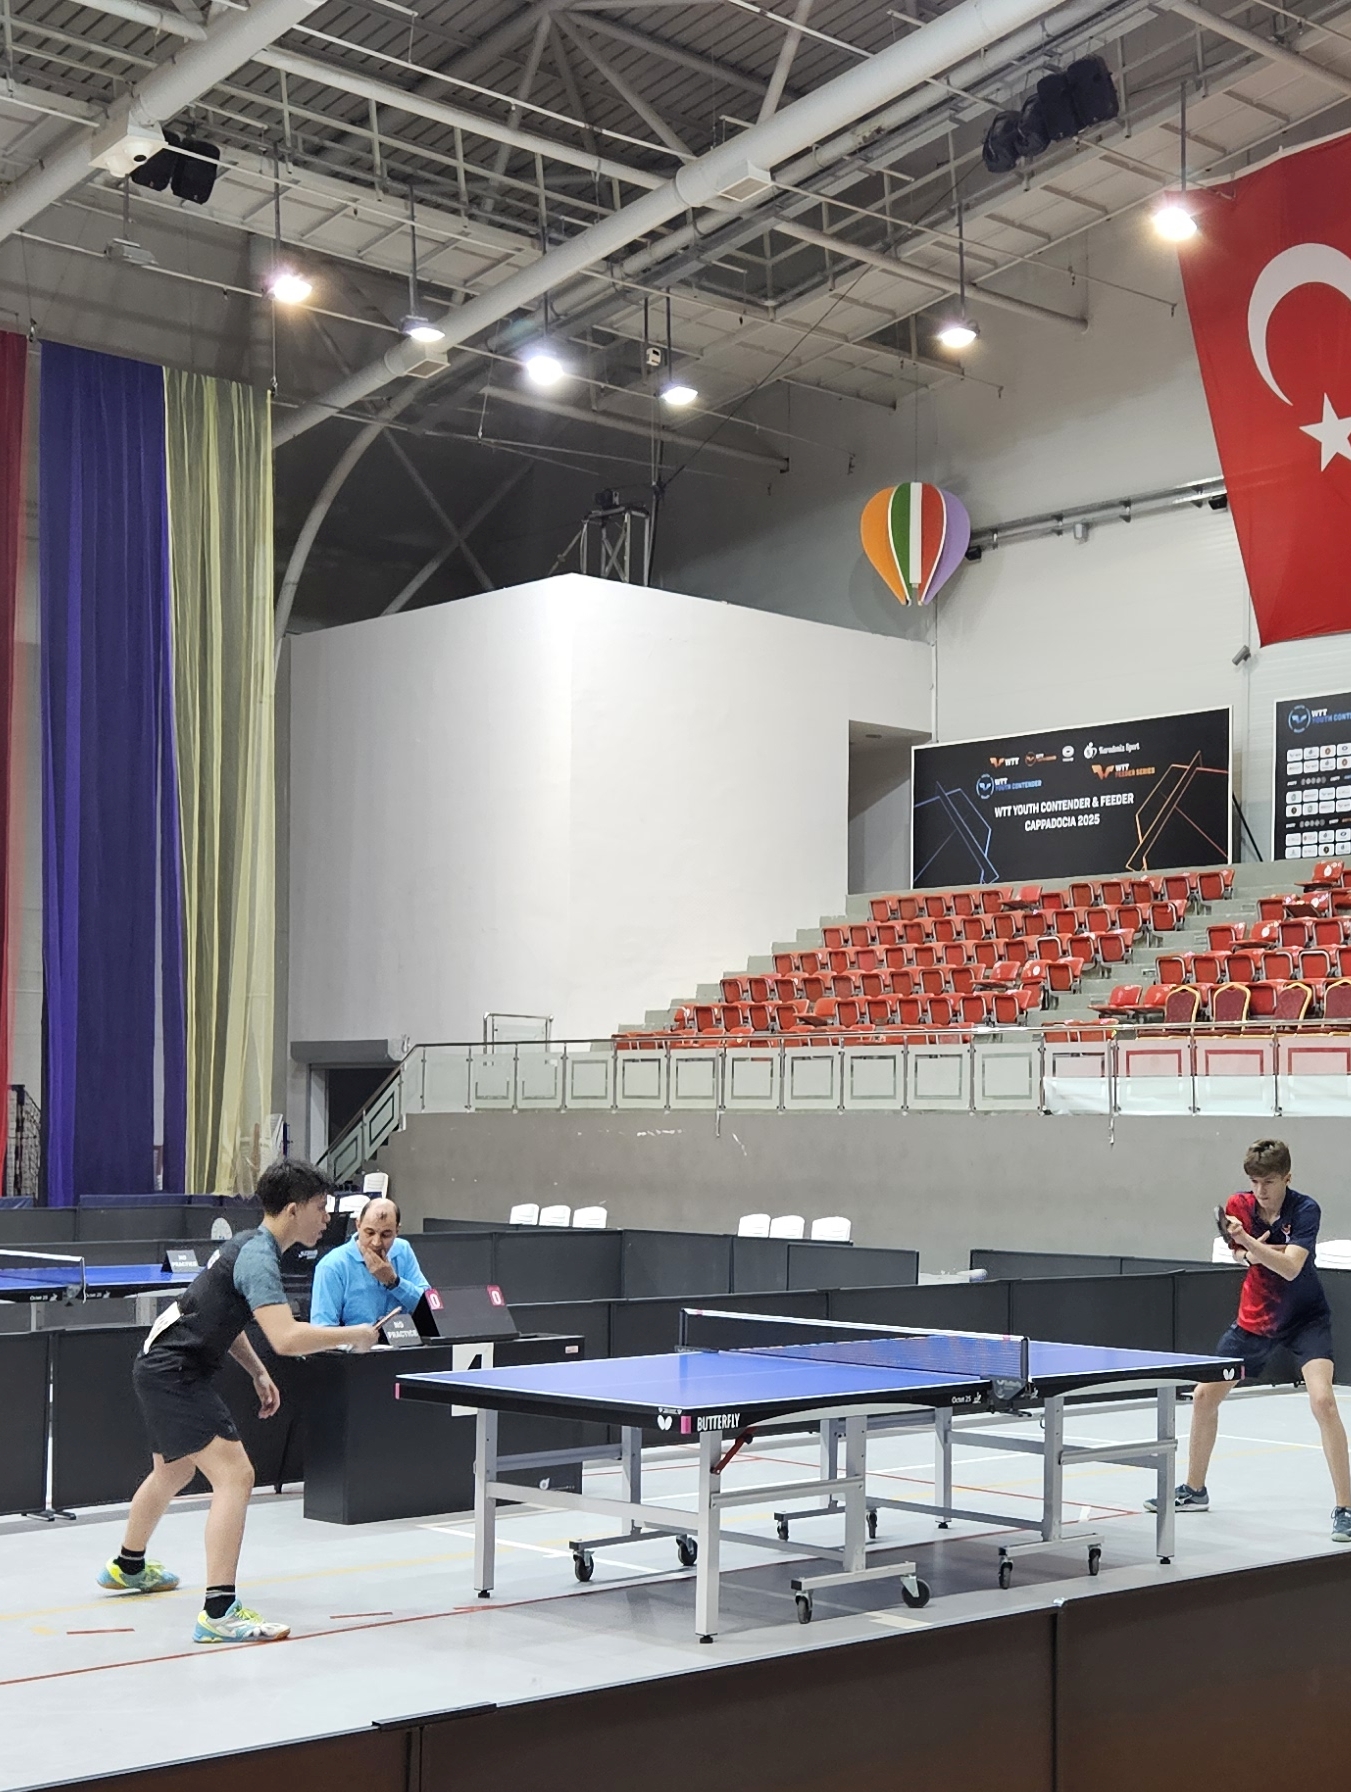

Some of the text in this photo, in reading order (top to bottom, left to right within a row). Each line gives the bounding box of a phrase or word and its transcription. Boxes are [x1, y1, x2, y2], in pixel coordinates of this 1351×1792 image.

[1311, 708, 1328, 717] WTT
[1004, 756, 1020, 767] WTT
[1114, 763, 1130, 772] WTT
[994, 792, 1134, 818] WTT YOUTH CONTENDER & FEEDER
[1024, 813, 1100, 832] CAPPADOCIA 2025
[429, 1293, 441, 1310] 0
[491, 1290, 502, 1306] 0
[393, 1320, 405, 1329] NO
[387, 1329, 419, 1339] PRACTICE
[696, 1412, 740, 1432] BUTTERFLY
